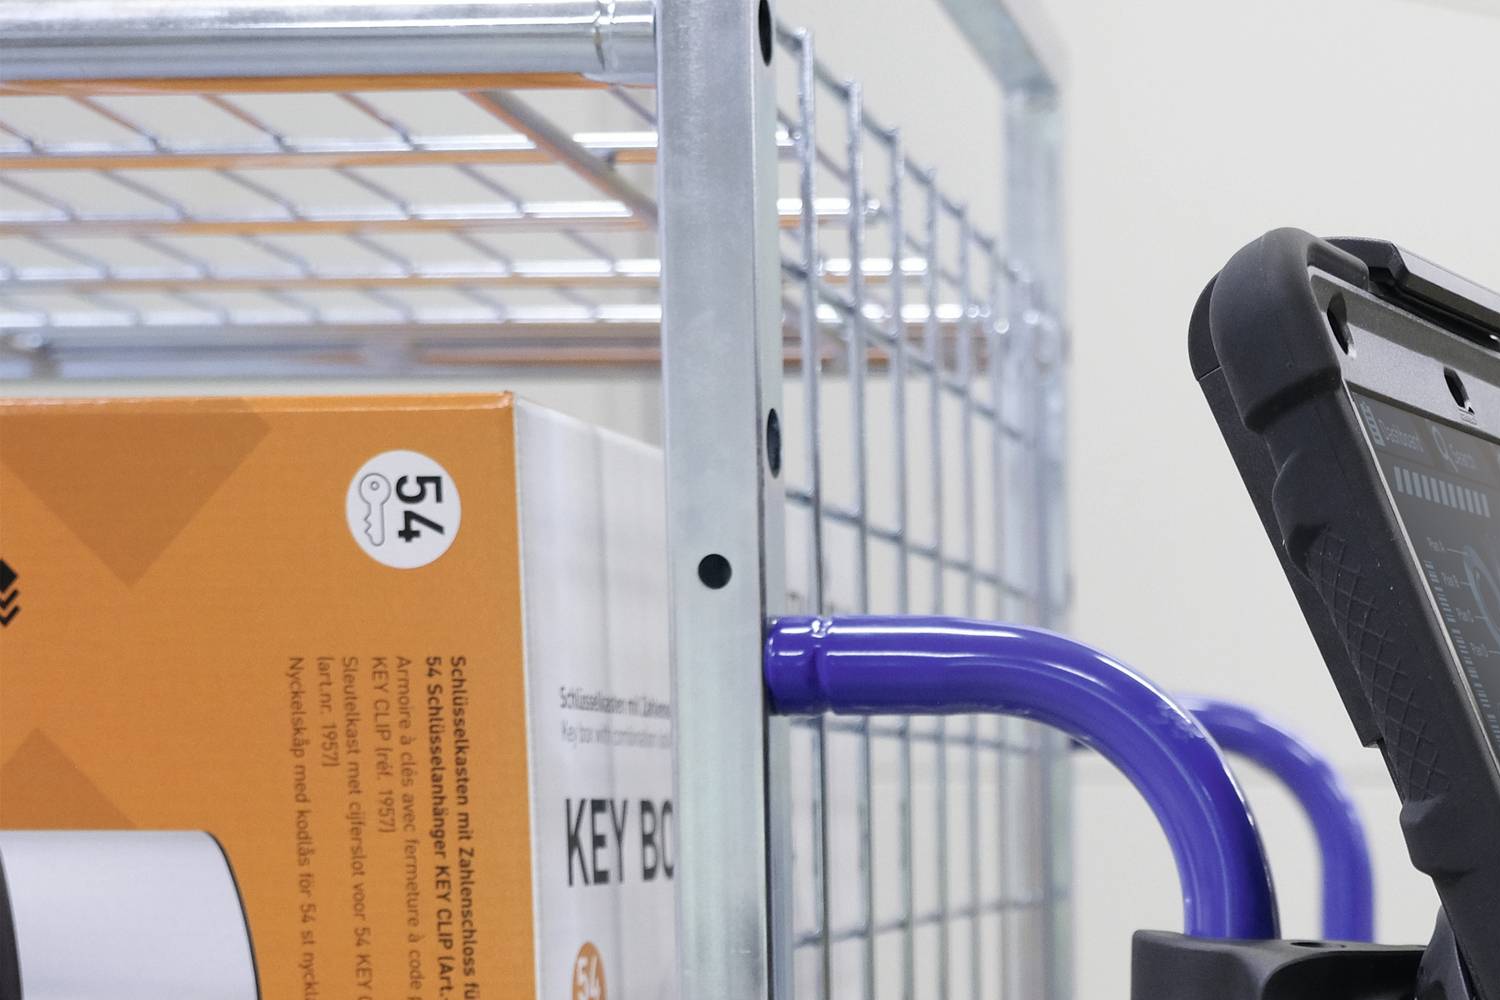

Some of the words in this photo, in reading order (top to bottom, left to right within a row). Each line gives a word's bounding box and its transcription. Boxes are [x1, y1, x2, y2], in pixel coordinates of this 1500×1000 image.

[396, 475, 444, 543] 54
[316, 656, 335, 714] (art.nr.
[372, 657, 389, 693] KEY
[426, 656, 442, 678] 54
[285, 657, 310, 758] Nyckelskåp
[342, 656, 361, 754] Sleutelkast
[396, 656, 412, 729] Armoire
[373, 699, 391, 741] CLIP
[450, 656, 469, 805] Schlüsselkasten
[321, 723, 340, 767] 1957)
[400, 735, 416, 746] à
[294, 764, 311, 803] med
[348, 761, 362, 795] met
[375, 747, 393, 780] (réf.
[400, 752, 417, 787] clés
[427, 684, 447, 858] Schlüsselanhänger
[378, 789, 396, 833] 1957)
[402, 793, 415, 831] avec
[457, 812, 473, 840] mit
[296, 810, 315, 866] kodlås
[345, 801, 367, 876] cijferslot
[565, 797, 627, 887] KEY
[298, 872, 314, 897] för
[352, 882, 366, 921] voor
[404, 839, 420, 927] fermeture
[435, 866, 451, 902] KEY
[300, 903, 316, 924] 54
[436, 908, 453, 950] CLIP
[458, 847, 477, 976] Zahlenschloss
[300, 930, 316, 945] st
[354, 927, 370, 947] 54
[408, 932, 425, 943] à
[355, 954, 372, 990] KEY
[408, 949, 425, 990] code
